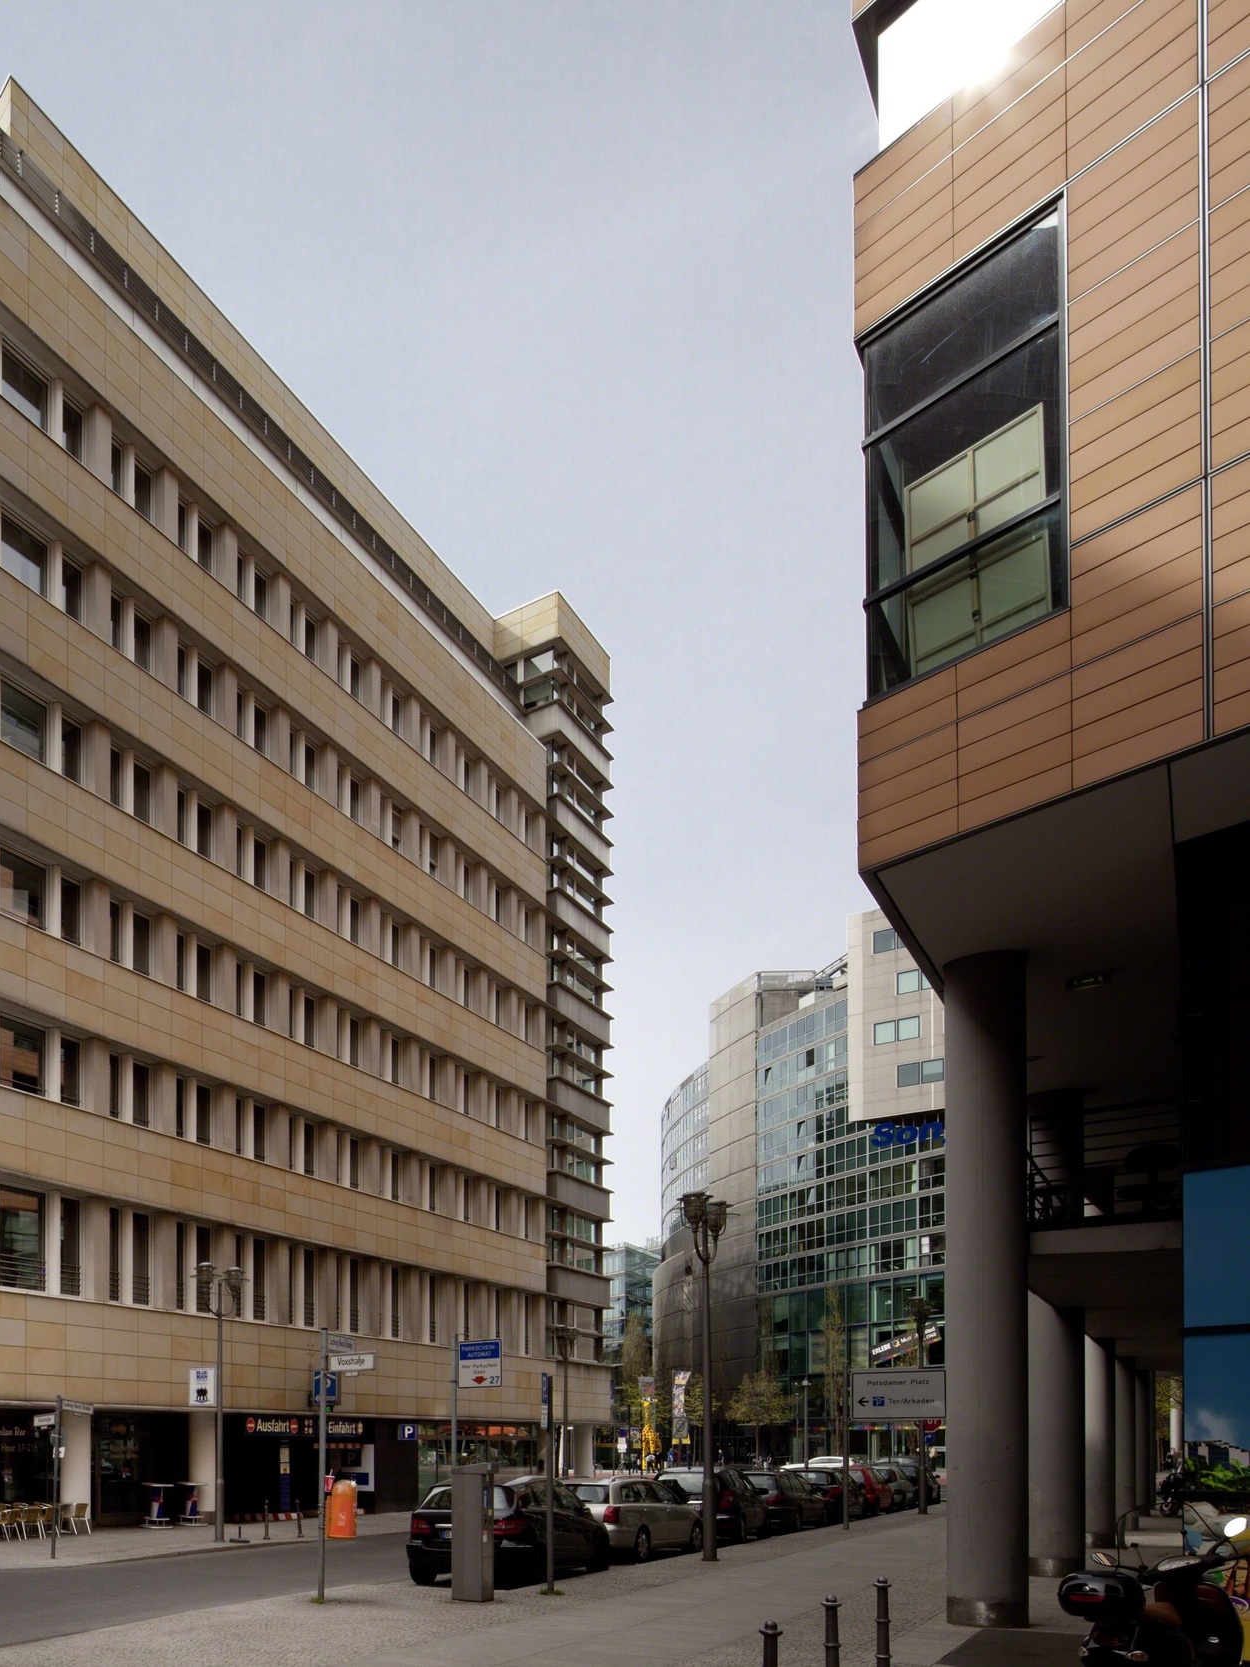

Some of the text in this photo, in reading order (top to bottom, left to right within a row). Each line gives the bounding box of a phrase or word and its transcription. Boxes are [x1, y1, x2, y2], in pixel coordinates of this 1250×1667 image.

[871, 1121, 946, 1147] Son
[489, 1376, 500, 1384] 27
[14, 1427, 26, 1436] Bar
[256, 1420, 290, 1432] Ausfahrt
[328, 1421, 356, 1434] Einfahrt
[404, 1425, 413, 1438] P
[1, 1443, 15, 1452] Hour
